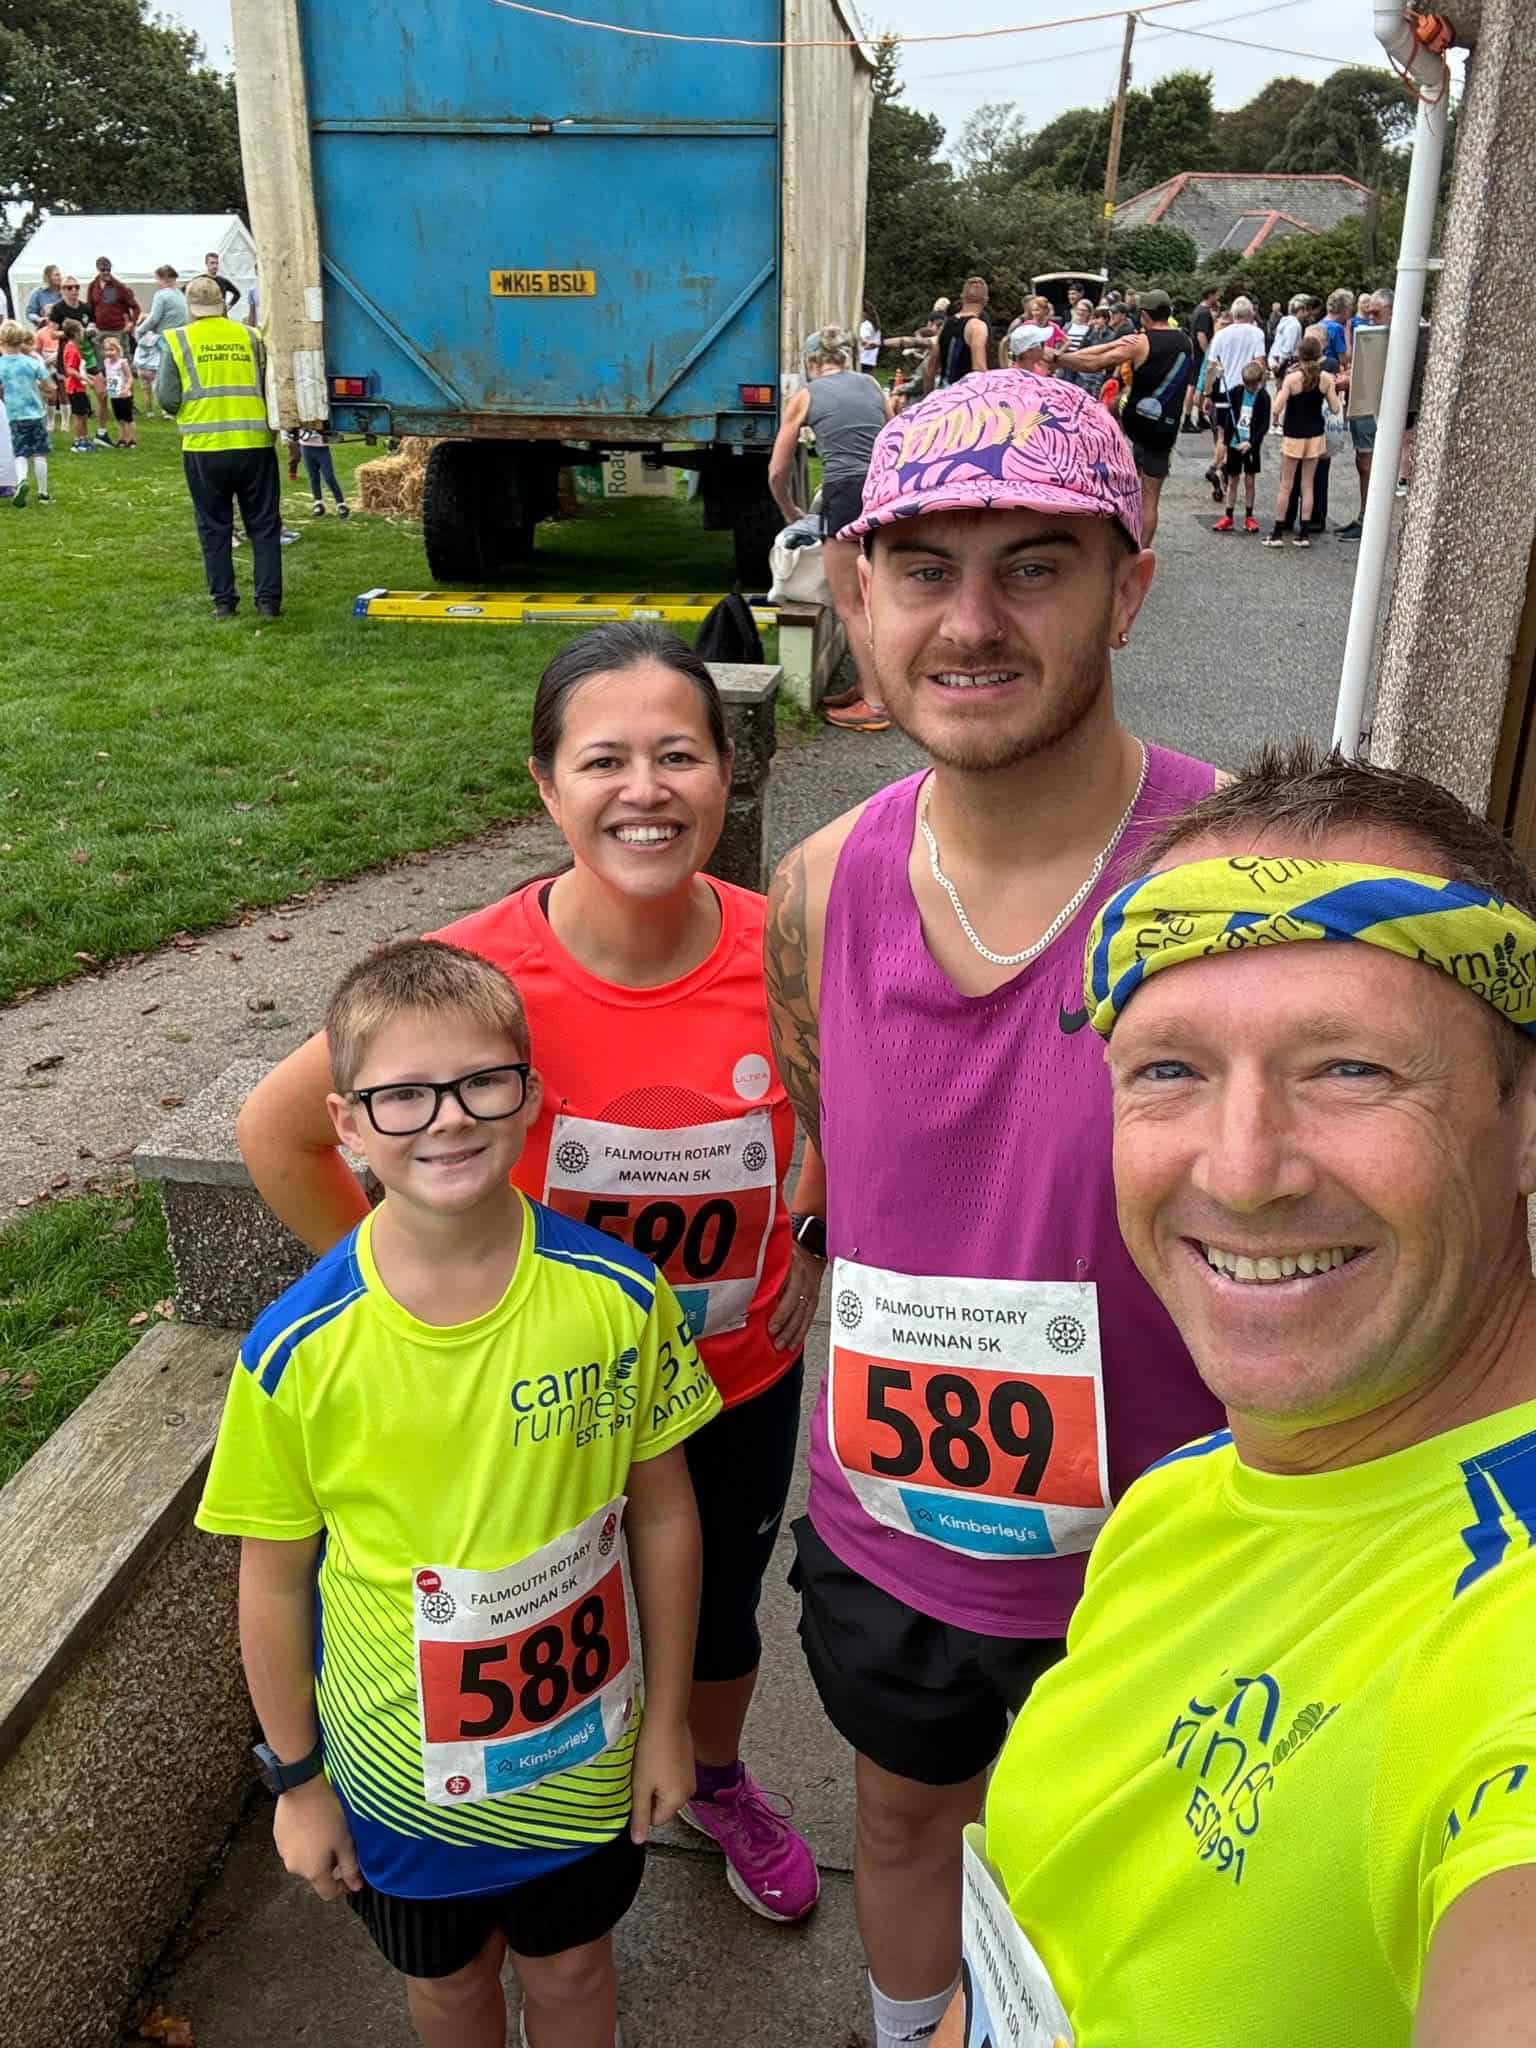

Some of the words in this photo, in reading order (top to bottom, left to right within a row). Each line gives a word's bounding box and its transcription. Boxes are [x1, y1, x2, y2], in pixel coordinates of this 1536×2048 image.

[502, 273, 543, 293] WK15
[604, 1145, 682, 1162] FALMOUTH
[684, 1143, 733, 1161] ROTARY
[618, 1169, 690, 1183] MAWNAN
[692, 1168, 712, 1182] 5K
[874, 1296, 957, 1321] FALMOUTH
[961, 1306, 1028, 1325] ROTARY
[891, 1327, 973, 1352] MAWNAN
[977, 1336, 1003, 1353] 5K
[511, 1360, 601, 1413] carn
[575, 1422, 603, 1448] EST.
[866, 1364, 1055, 1497] 589
[937, 1513, 1039, 1543] Kimberley's
[470, 1570, 548, 1605] FALMOUTH
[549, 1541, 593, 1576] ROTARY
[489, 1586, 559, 1626] MAWNAN
[561, 1574, 579, 1595] 5K
[459, 1595, 612, 1737] 588
[518, 1722, 597, 1769] Kimberley's
